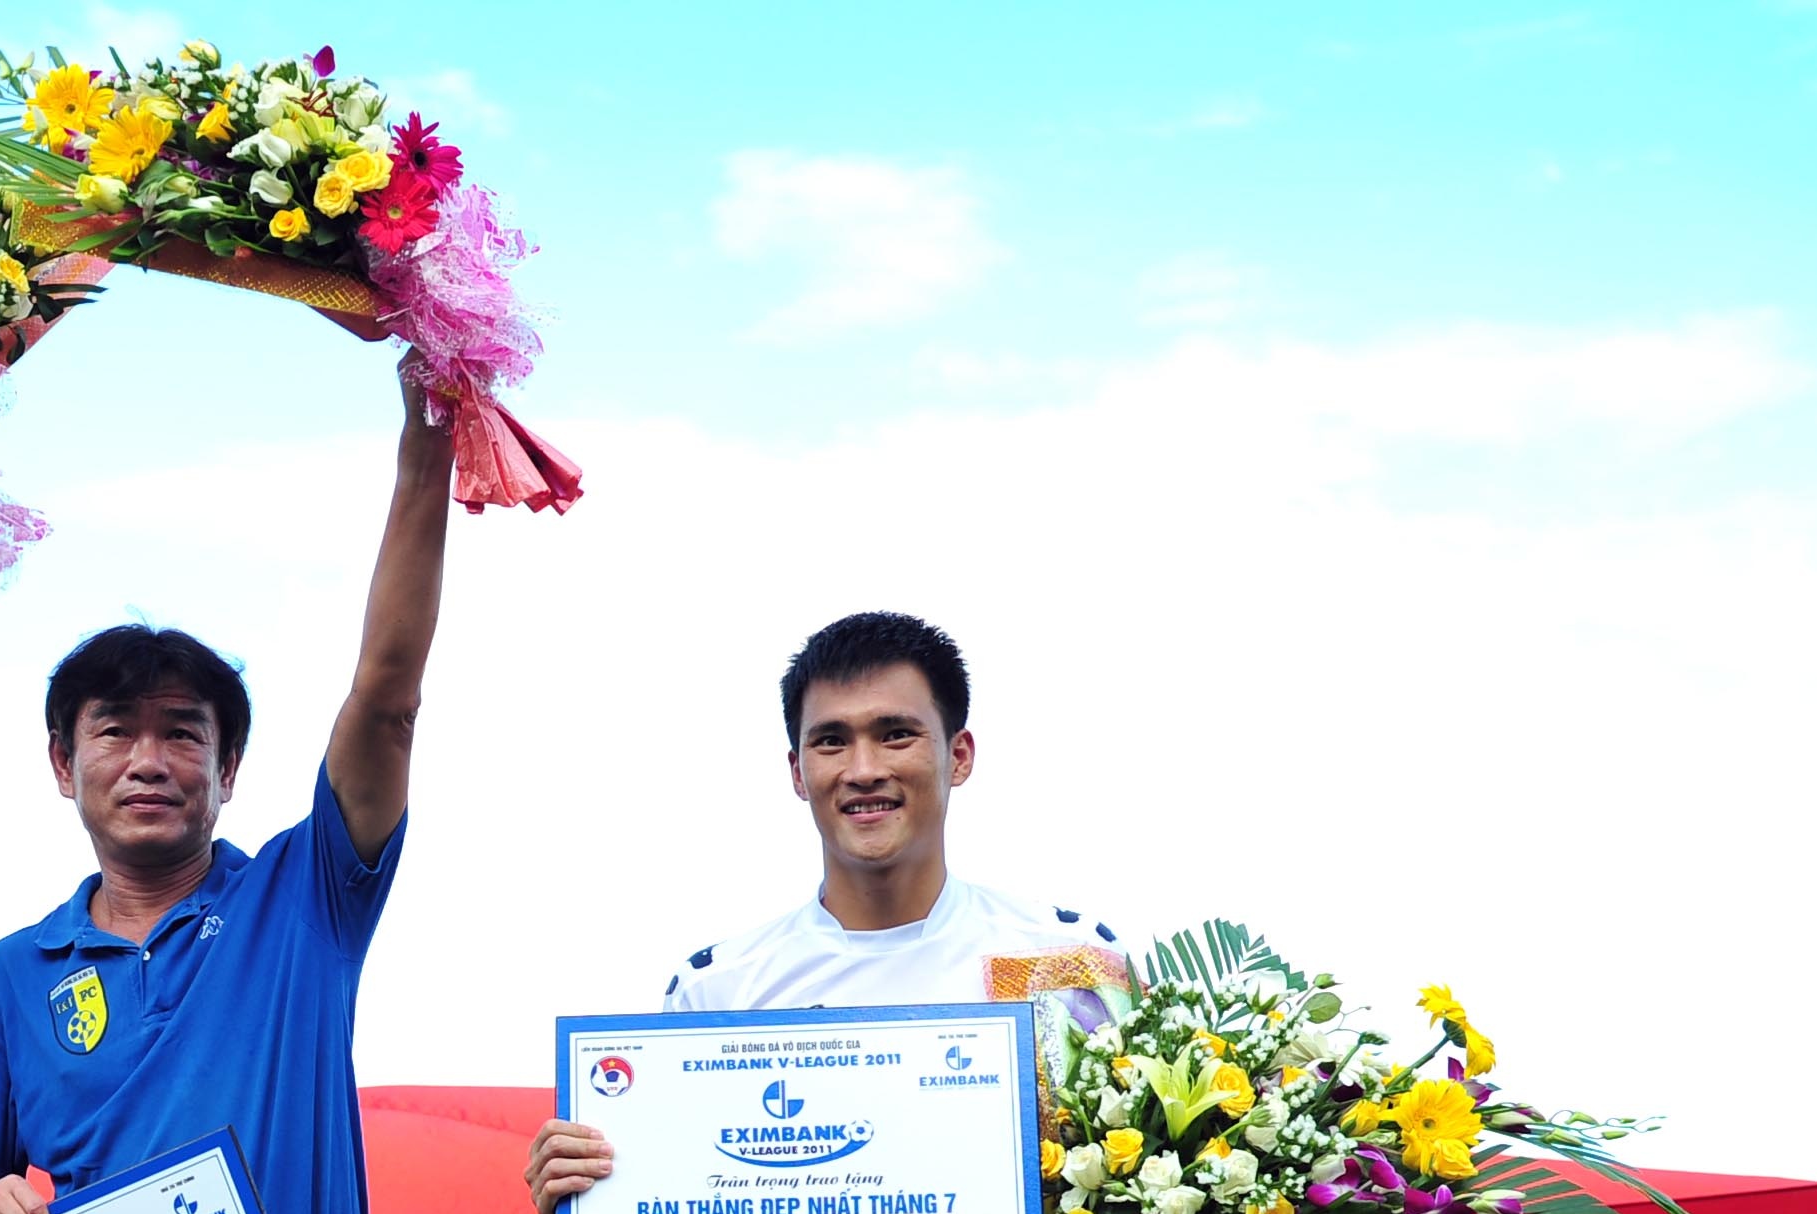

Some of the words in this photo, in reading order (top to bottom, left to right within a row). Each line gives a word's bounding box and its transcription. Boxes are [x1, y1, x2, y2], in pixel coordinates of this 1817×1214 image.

[845, 1040, 861, 1050] GIA
[683, 1057, 773, 1072] EXIMBANK
[777, 1054, 859, 1068] V-LEAGUE
[864, 1053, 902, 1066] 2011
[919, 1074, 1000, 1087] EXIMBANK
[721, 1125, 848, 1144] EXIMBANK
[739, 1146, 799, 1156] V-LEAGUE
[802, 1145, 833, 1155] 2011
[755, 1175, 800, 1191] trọng
[805, 1174, 840, 1187] trao
[943, 1193, 957, 1213] 7
